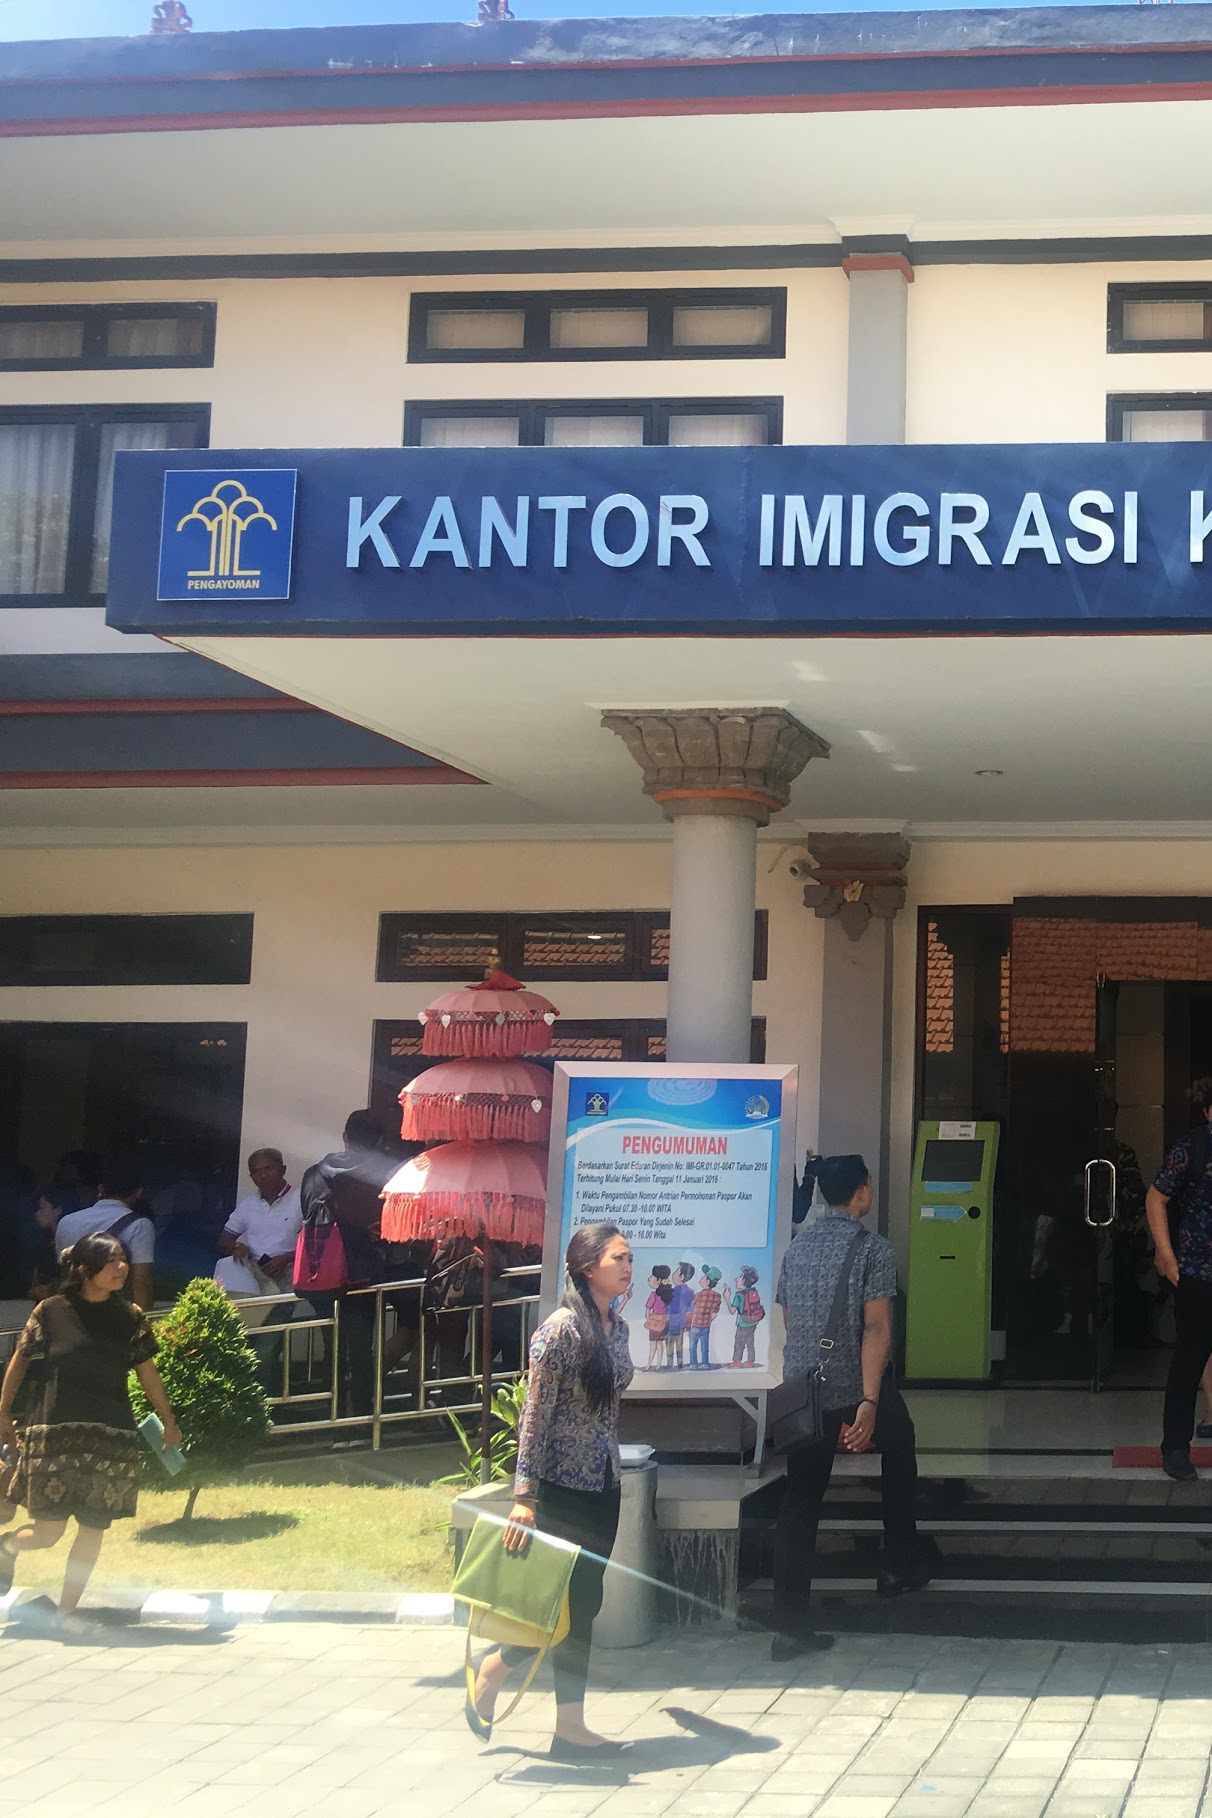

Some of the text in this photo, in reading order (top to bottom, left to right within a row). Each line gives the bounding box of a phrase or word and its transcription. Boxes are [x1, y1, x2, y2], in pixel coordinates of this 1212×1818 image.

[346, 493, 712, 569] KANTOR
[759, 490, 1138, 566] IMIGRASI
[187, 580, 260, 589] PENGAYOMAN
[622, 1136, 728, 1155] PENGUMUMAN
[578, 1160, 613, 1171] Berdasarkan
[615, 1160, 630, 1170] Surat
[631, 1160, 650, 1171] Edaran
[737, 1162, 753, 1171] Tahun
[754, 1162, 768, 1171] 2016
[577, 1173, 604, 1184] Terhitung
[605, 1174, 620, 1183] Mulai
[621, 1174, 633, 1183] Hari
[635, 1174, 650, 1183] Senin
[652, 1174, 675, 1185] Tanggal
[676, 1175, 682, 1183] 11
[683, 1175, 703, 1184] Januari
[582, 1191, 600, 1200] Waktu
[601, 1191, 637, 1201] Pengambilan
[639, 1191, 658, 1200] Nomor
[659, 1191, 679, 1200] Antrian
[680, 1191, 716, 1200] Permohonan
[717, 1191, 737, 1202] Paspor
[738, 1192, 752, 1200] Akan
[581, 1203, 604, 1214] Dilayani
[605, 1203, 622, 1213] Pukul
[656, 1204, 672, 1213] WITA
[618, 1217, 638, 1228] Paspor
[640, 1217, 654, 1228] Yang
[655, 1217, 673, 1226] Sudah
[674, 1217, 695, 1226] Selesai
[653, 1230, 666, 1239] Wita
